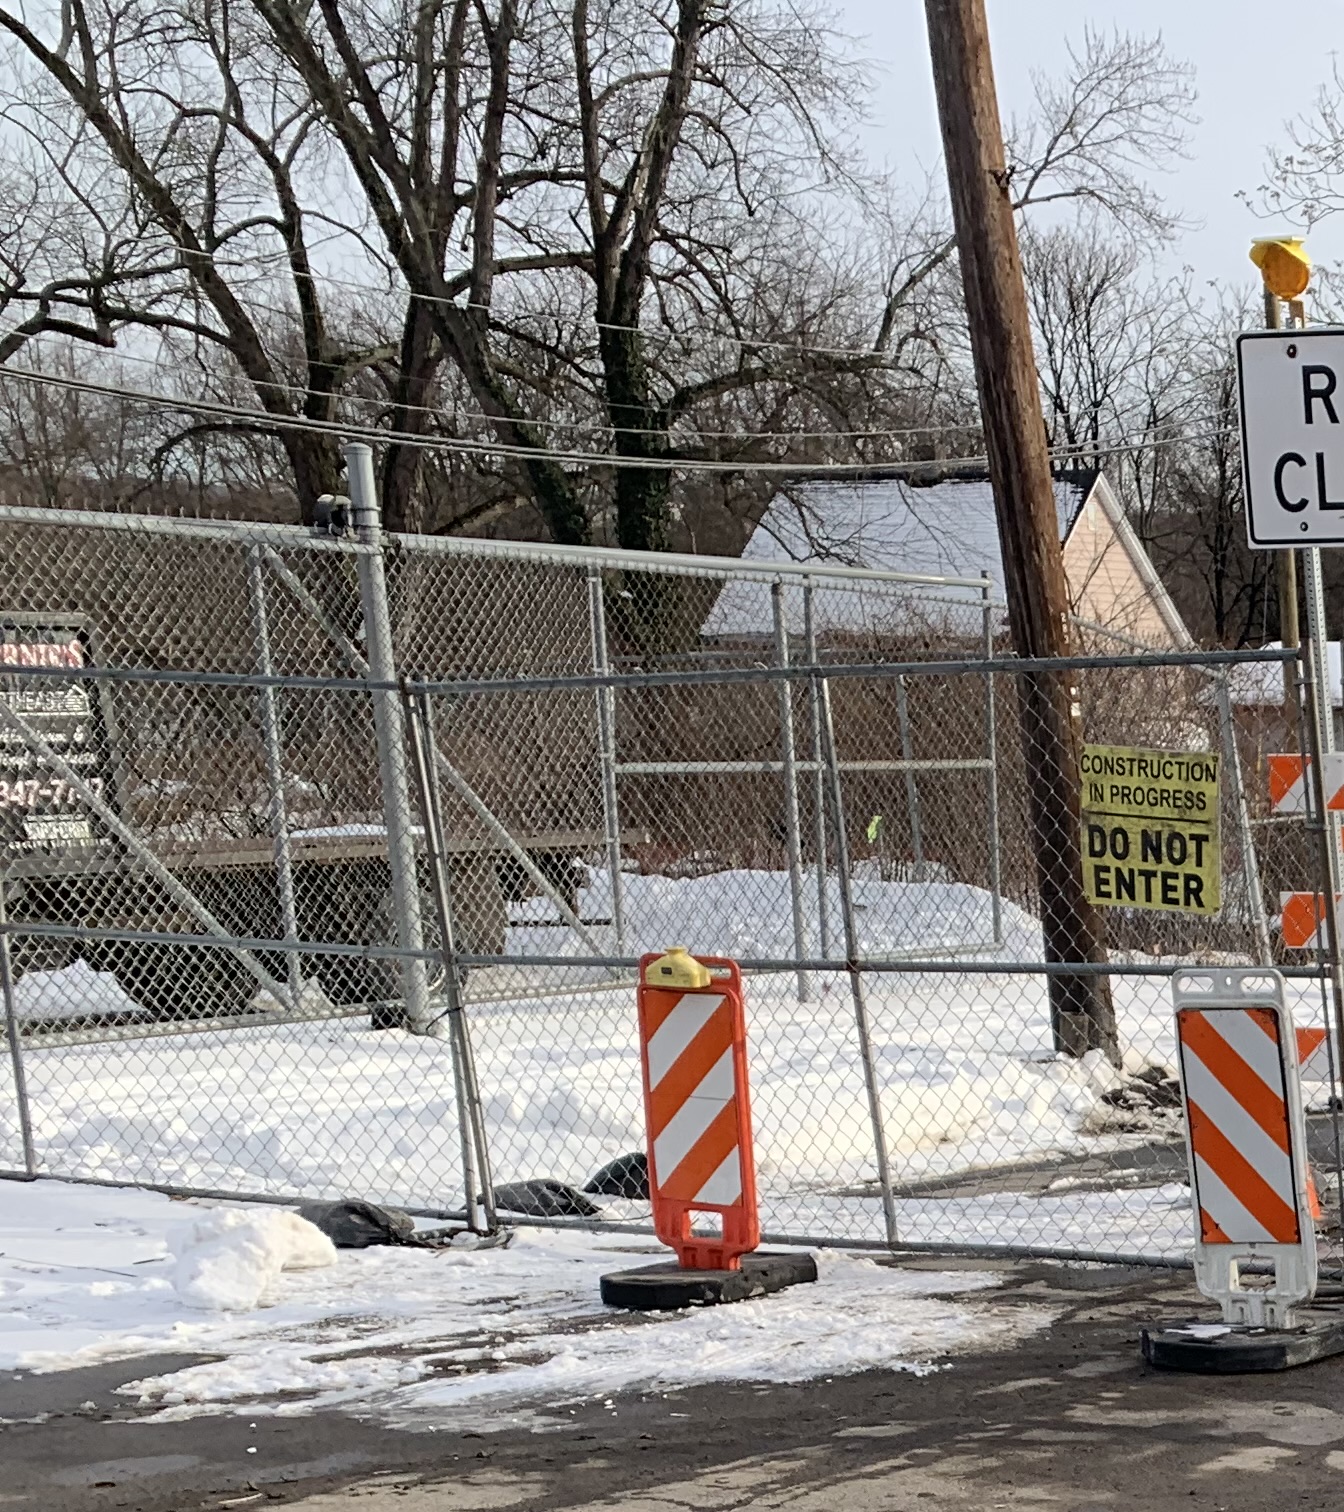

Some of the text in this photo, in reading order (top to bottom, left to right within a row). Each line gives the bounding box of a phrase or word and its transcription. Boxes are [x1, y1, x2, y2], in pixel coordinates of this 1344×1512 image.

[1081, 754, 1216, 782] CONSTRUCTION
[1089, 783, 1207, 811] IN PROGRESS
[1088, 824, 1209, 868] DO NOT
[1094, 864, 1205, 908] ENTER
